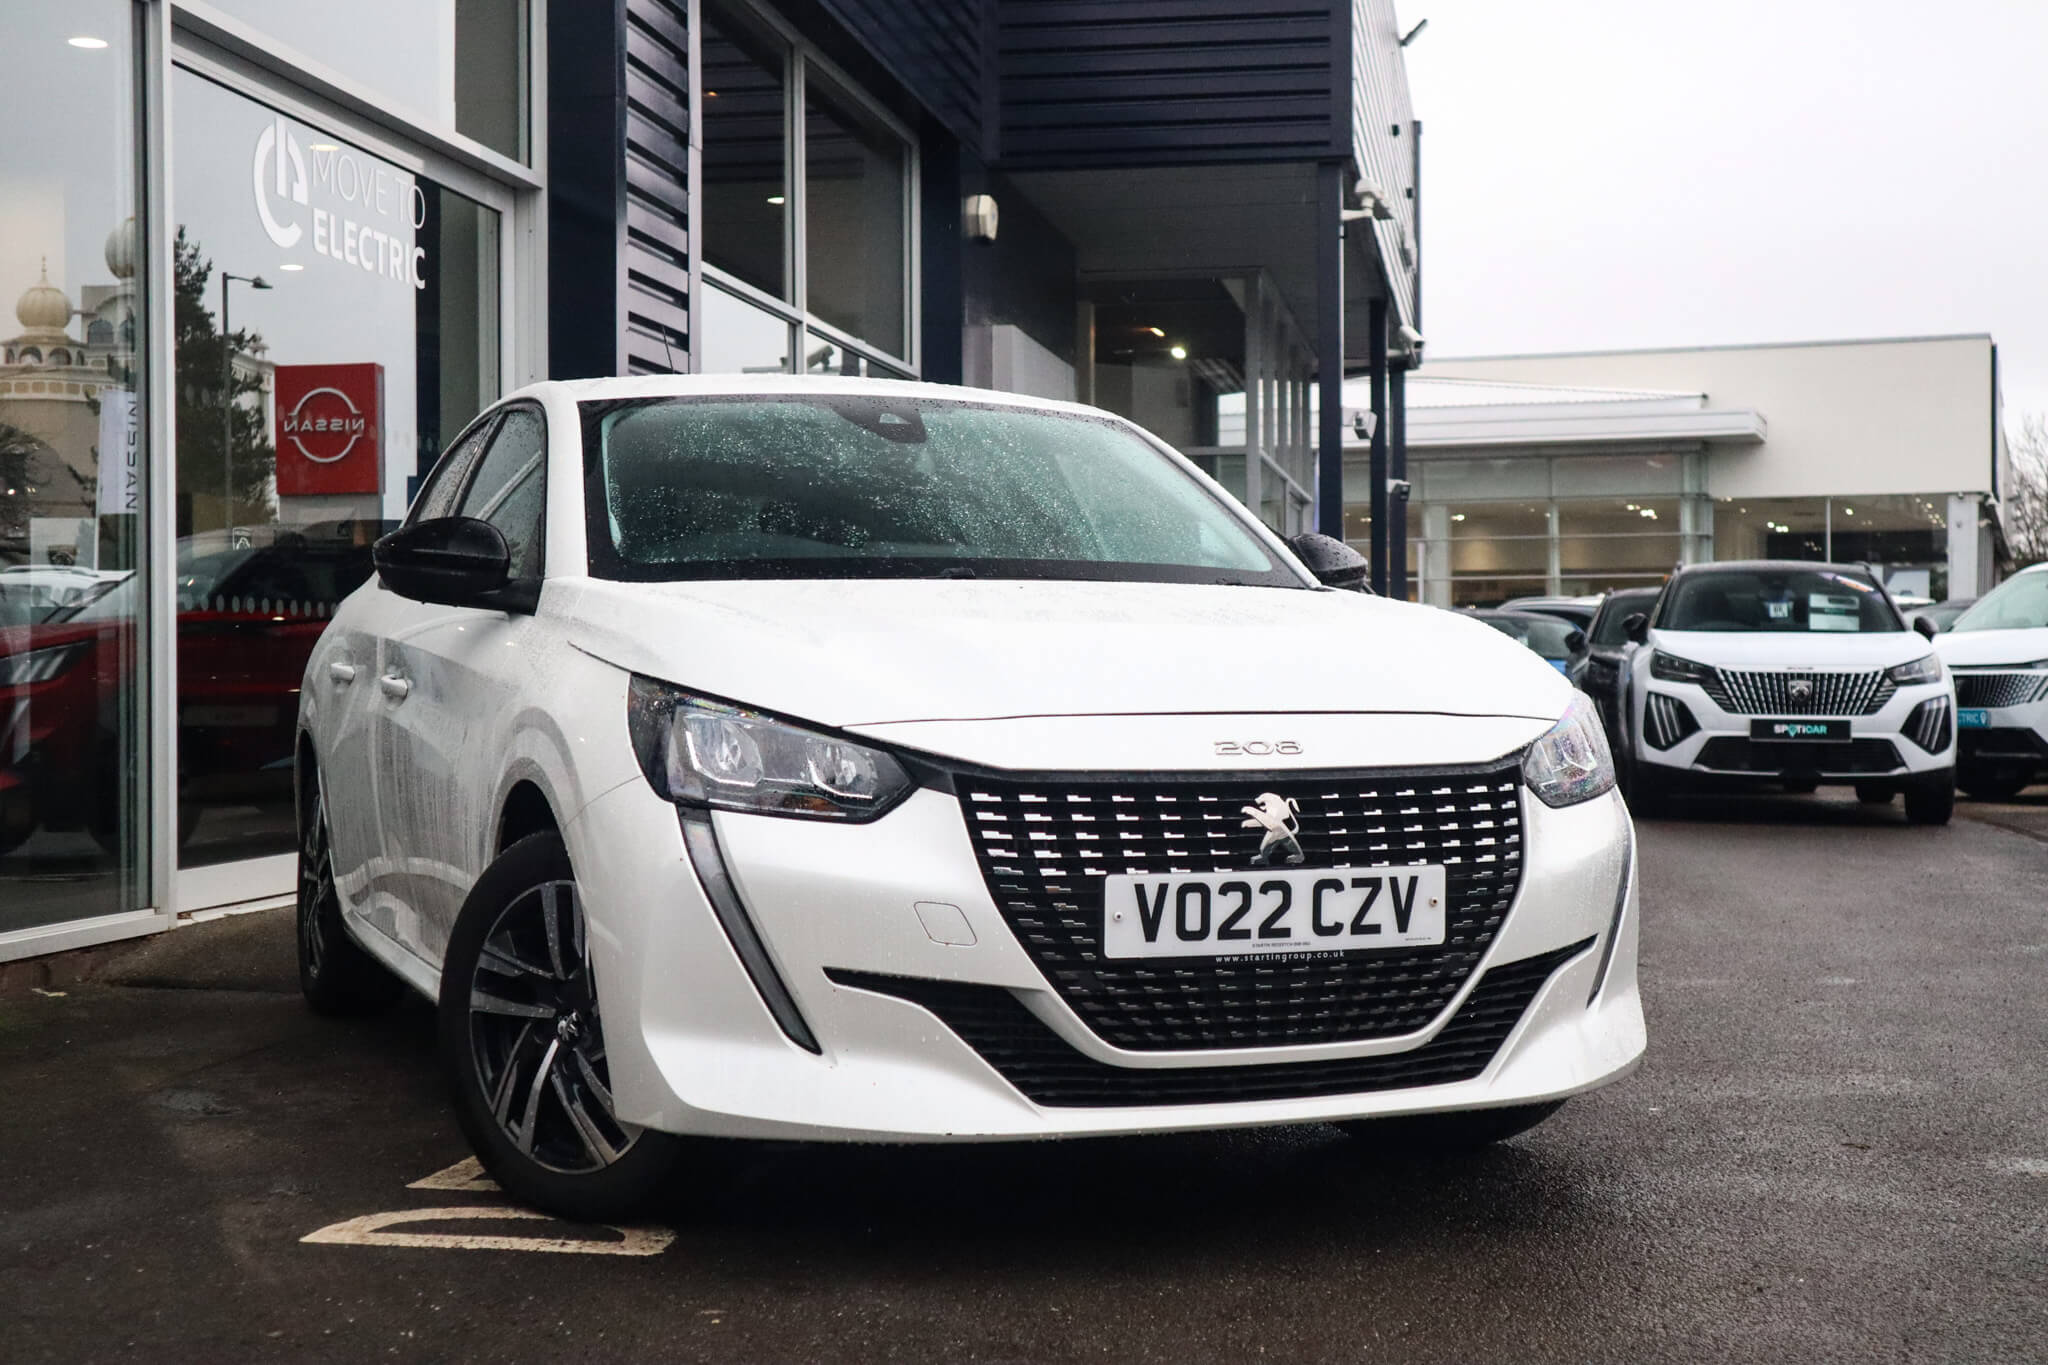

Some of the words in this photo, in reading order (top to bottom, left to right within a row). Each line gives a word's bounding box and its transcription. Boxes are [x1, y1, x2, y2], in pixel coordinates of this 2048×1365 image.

[312, 142, 388, 215] MOVE
[395, 176, 426, 230] TO
[313, 207, 426, 289] ELECTRIC
[1214, 740, 1304, 756] 208
[1773, 723, 1828, 738] SPOTICAR
[1134, 879, 1292, 943] VO22
[1312, 876, 1419, 937] CZV
[1215, 949, 1345, 964] www.startingroup.co.uk
